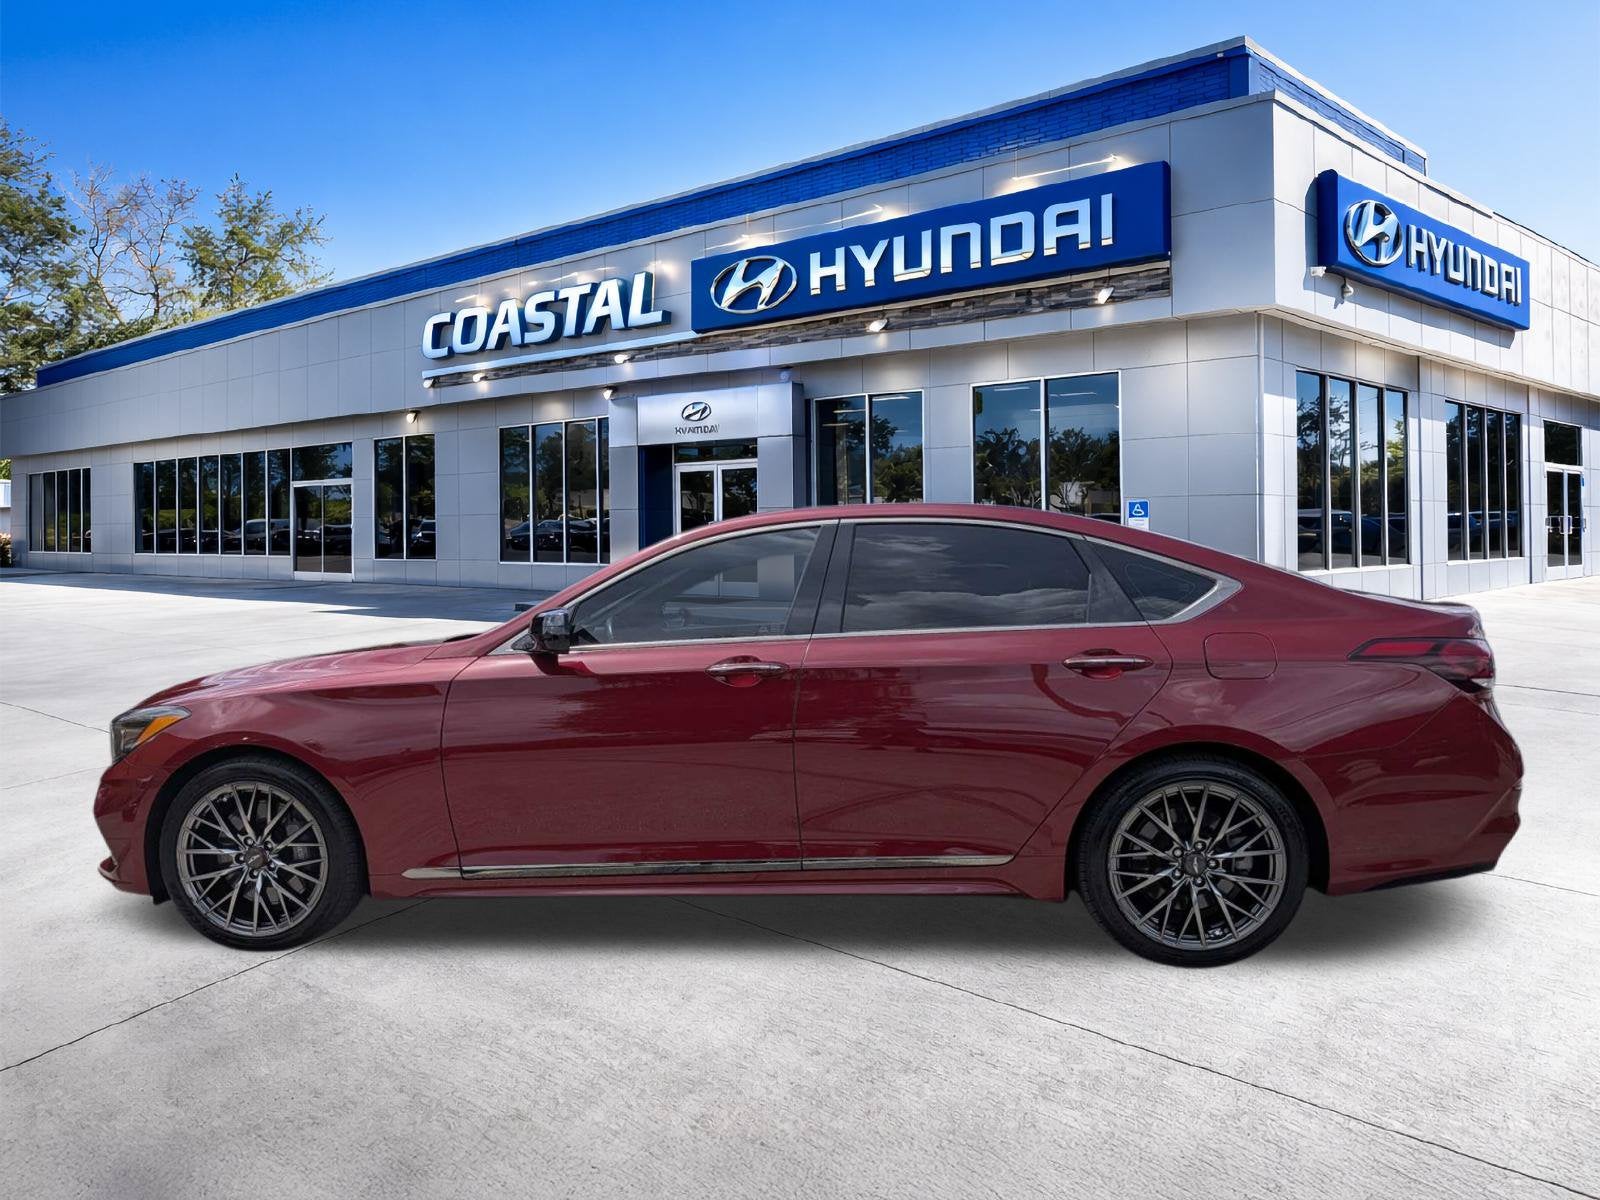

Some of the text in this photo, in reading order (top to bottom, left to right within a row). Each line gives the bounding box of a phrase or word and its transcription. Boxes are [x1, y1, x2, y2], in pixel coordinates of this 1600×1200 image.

[809, 192, 1114, 297] HYUNDAI
[1406, 223, 1523, 307] HYUNDAI
[422, 271, 667, 360] COASTAL
